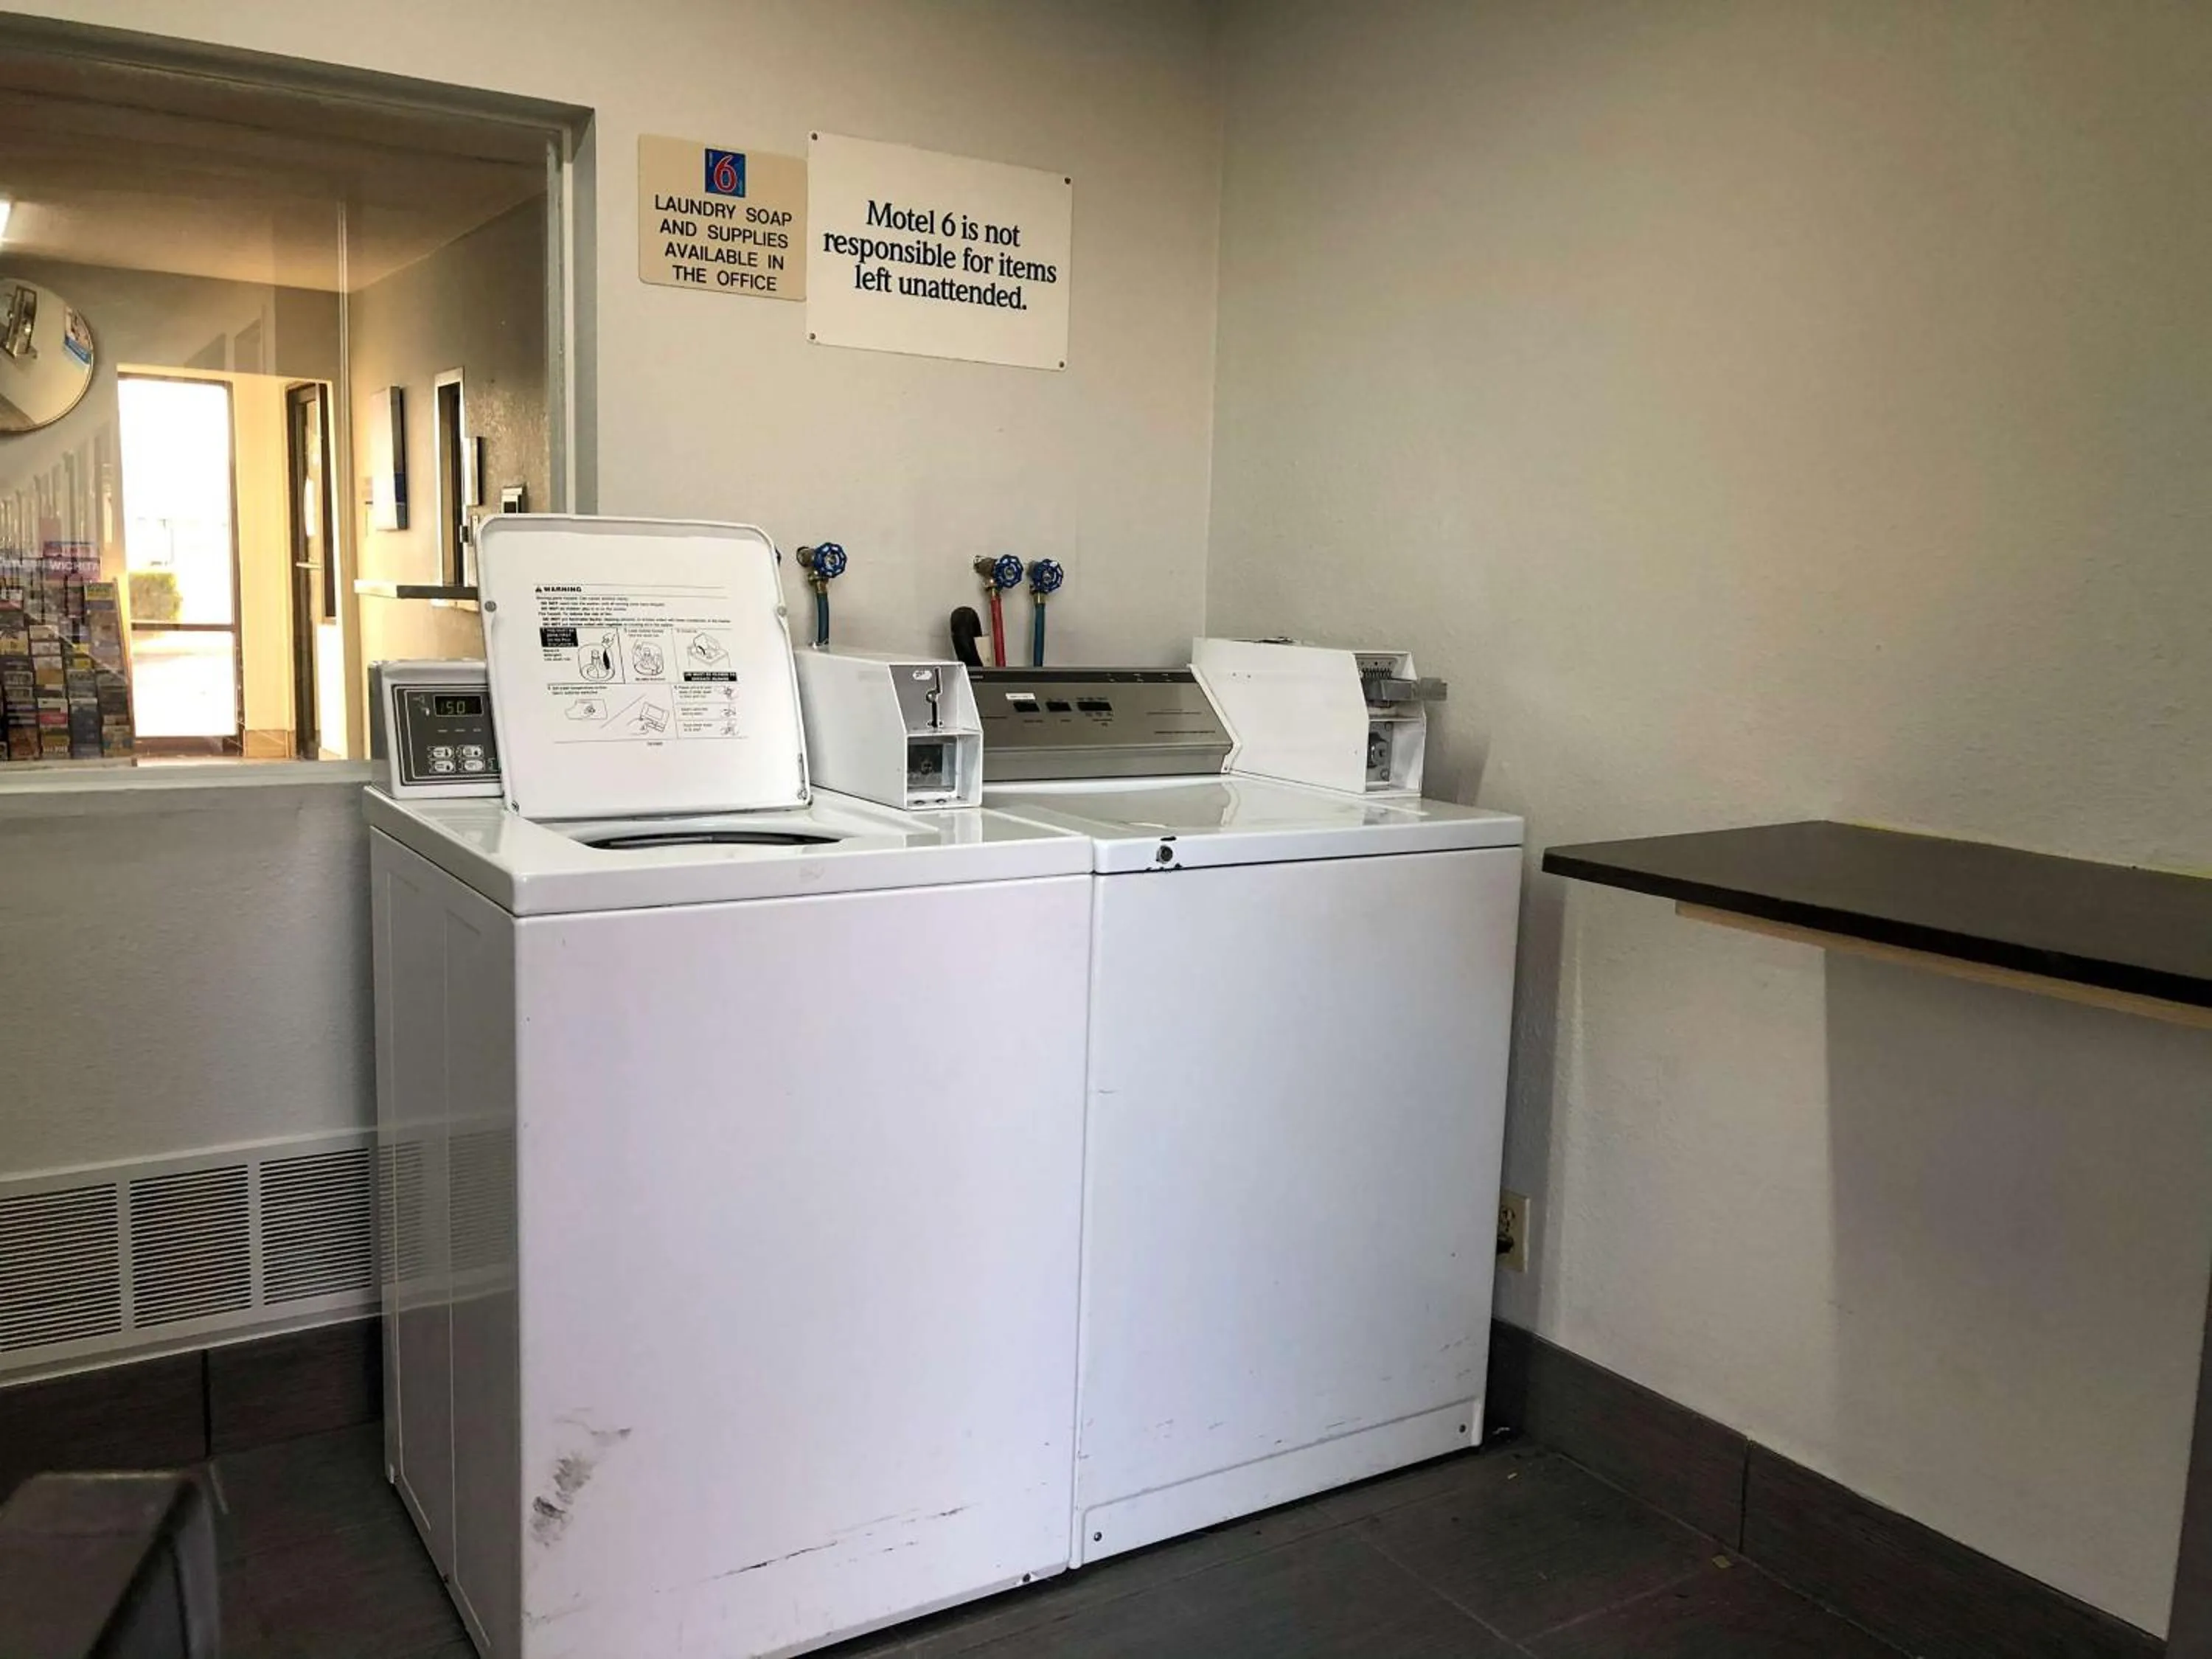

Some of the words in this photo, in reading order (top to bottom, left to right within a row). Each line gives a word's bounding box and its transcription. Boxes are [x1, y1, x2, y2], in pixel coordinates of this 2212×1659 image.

[713, 154, 738, 192] 6
[655, 194, 737, 220] LAUNDRY
[745, 207, 793, 227] SOAP
[866, 200, 935, 234] Motel
[941, 212, 956, 237] 6
[961, 215, 978, 241] is
[984, 224, 1020, 248] not
[659, 218, 698, 237] AND
[707, 224, 788, 249] SUPPLIES
[664, 241, 758, 268] AVAILABLE
[768, 254, 784, 271] IN
[824, 232, 956, 269] responsible
[962, 246, 994, 274] for
[998, 251, 1057, 284] items
[672, 265, 707, 284] THE
[717, 270, 777, 292] OFFICE
[855, 264, 892, 293] left
[899, 276, 1027, 310] unattended.
